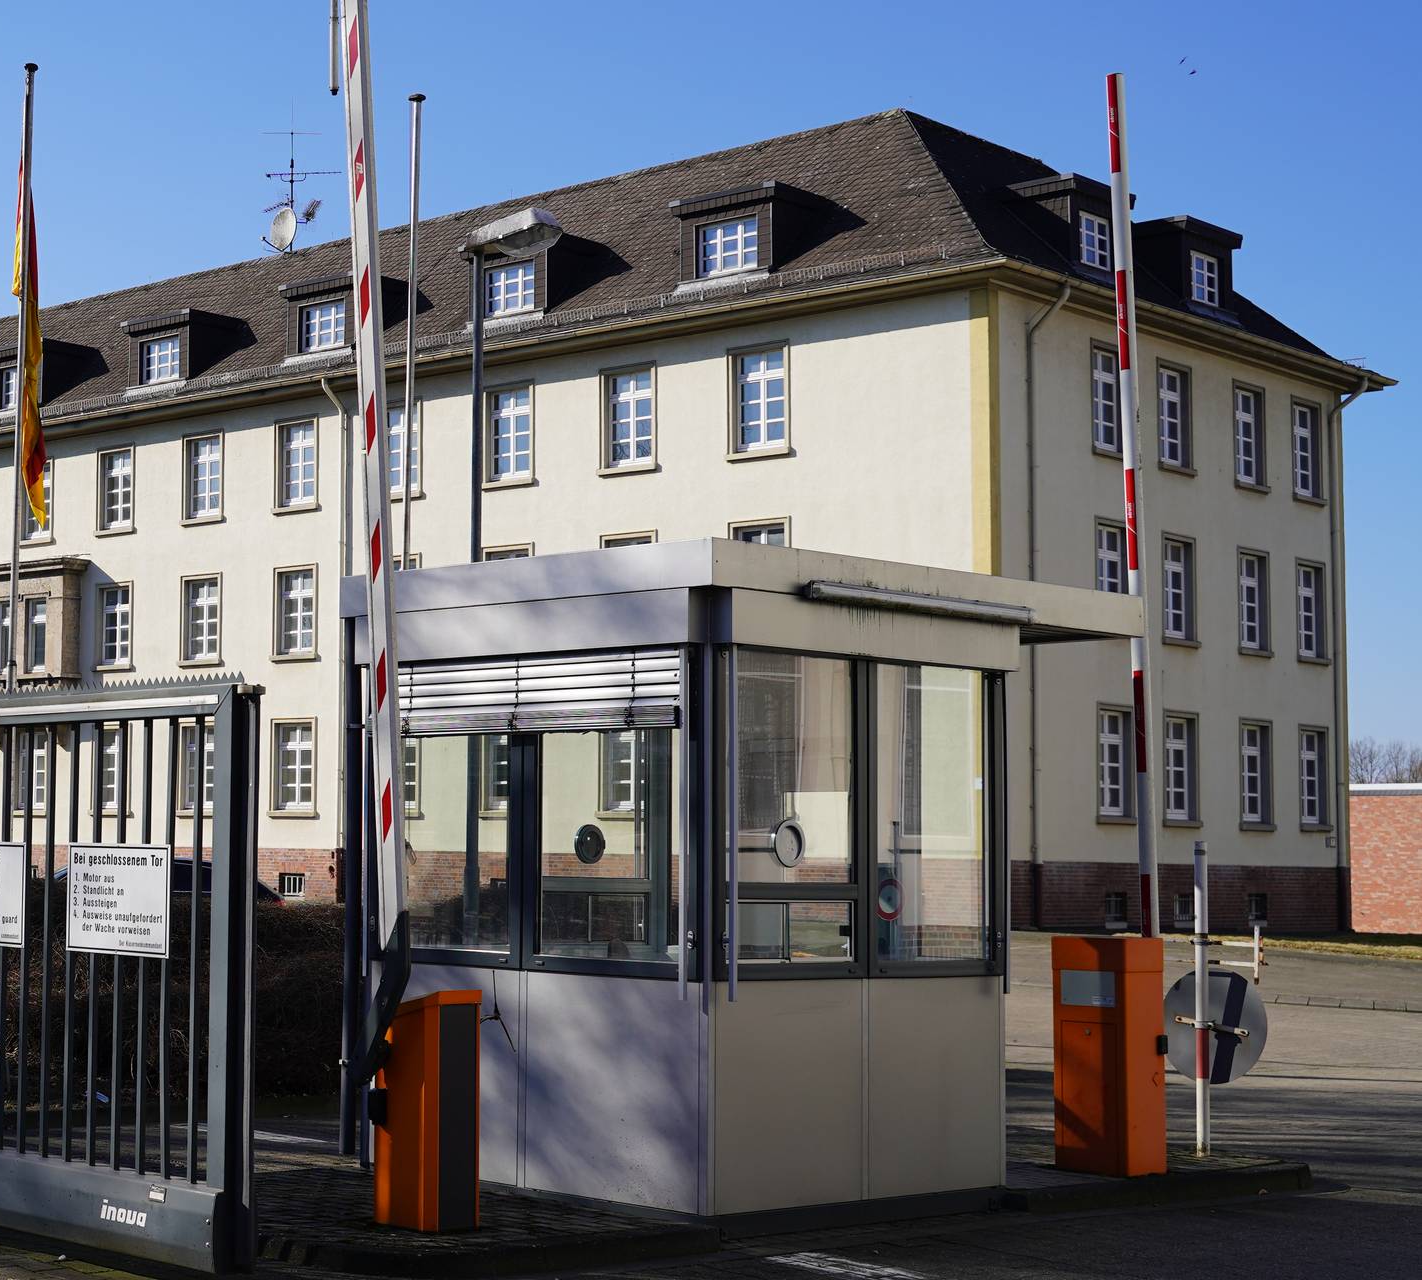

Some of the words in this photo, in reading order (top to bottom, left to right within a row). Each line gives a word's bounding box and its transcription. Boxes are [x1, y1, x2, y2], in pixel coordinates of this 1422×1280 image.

[73, 852, 86, 865] Bei
[88, 852, 148, 867] geschlossenem
[150, 854, 163, 867] Tor
[75, 872, 80, 882] 1.
[82, 872, 101, 883] Motor
[103, 875, 115, 883] aus
[73, 884, 80, 894] 2.
[82, 884, 115, 896] Standlicht
[116, 887, 125, 896] an
[73, 896, 80, 906] 3.
[82, 897, 118, 909] Aussteigen
[1, 914, 18, 925] guard
[73, 909, 79, 919] 4.
[82, 909, 113, 921] Ausweise
[114, 912, 163, 924] unaufgefordert
[81, 922, 93, 932] der
[94, 923, 116, 934] Wache
[117, 925, 151, 936] vorweisen
[100, 1199, 147, 1228] inova
